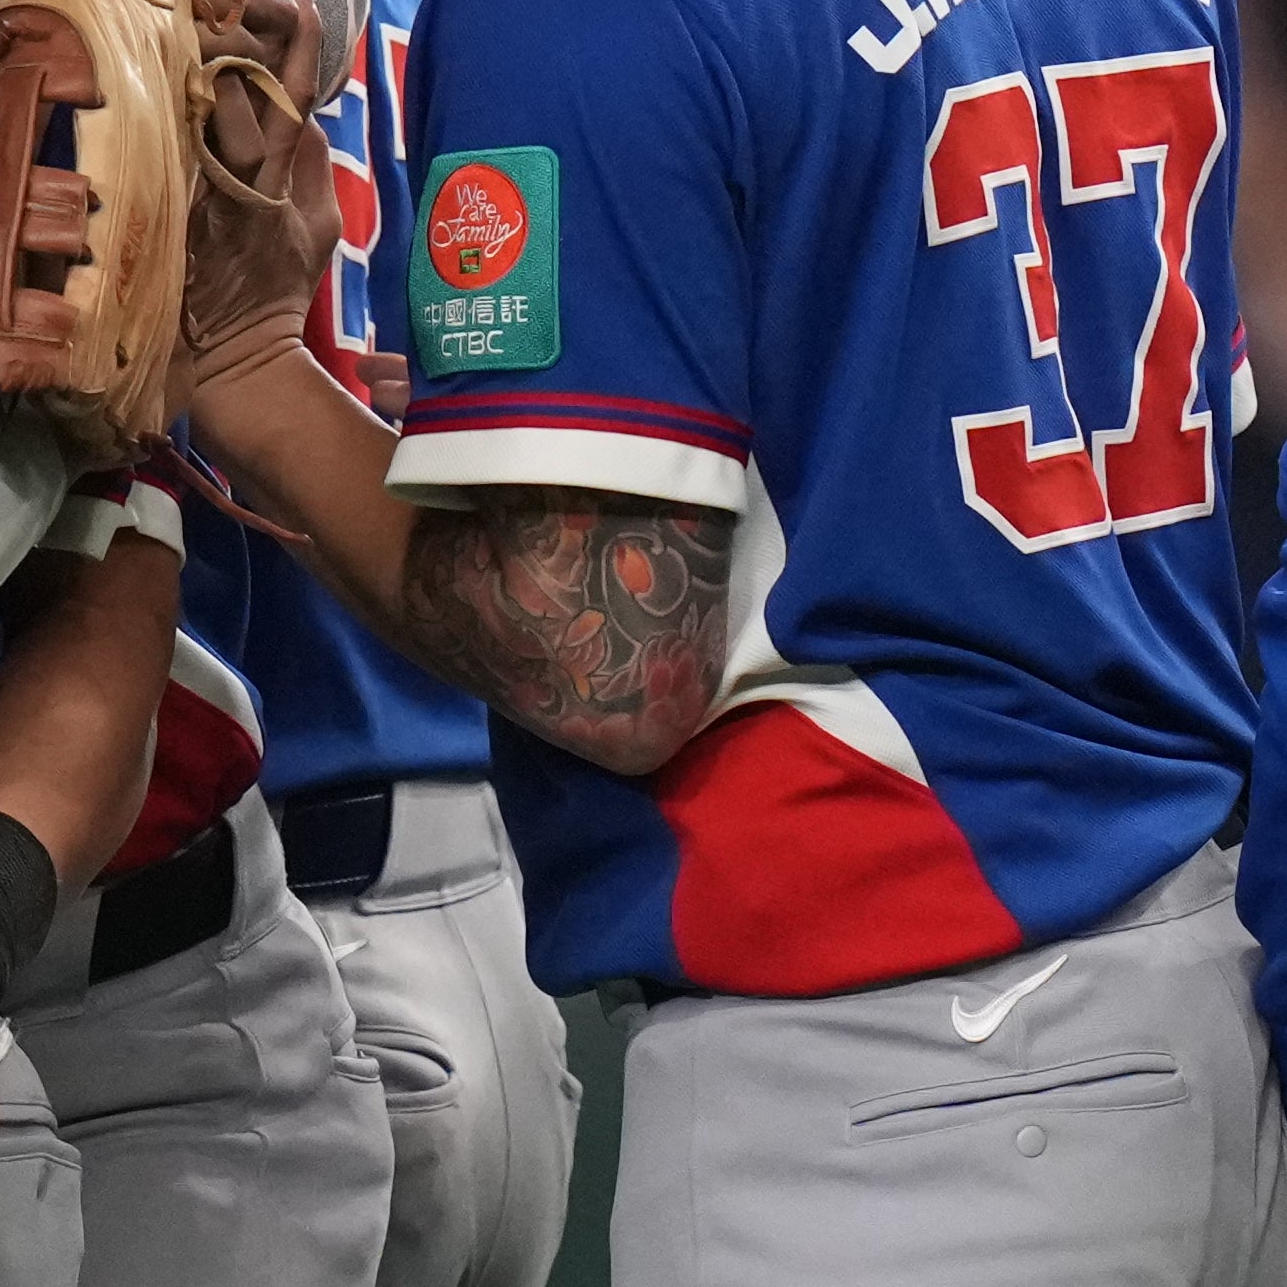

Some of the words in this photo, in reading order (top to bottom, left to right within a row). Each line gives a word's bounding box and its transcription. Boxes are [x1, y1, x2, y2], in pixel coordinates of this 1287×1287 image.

[455, 183, 488, 208] We
[423, 295, 529, 328] 中國信託
[923, 46, 1228, 554] 37
[440, 330, 505, 357] CTBC
